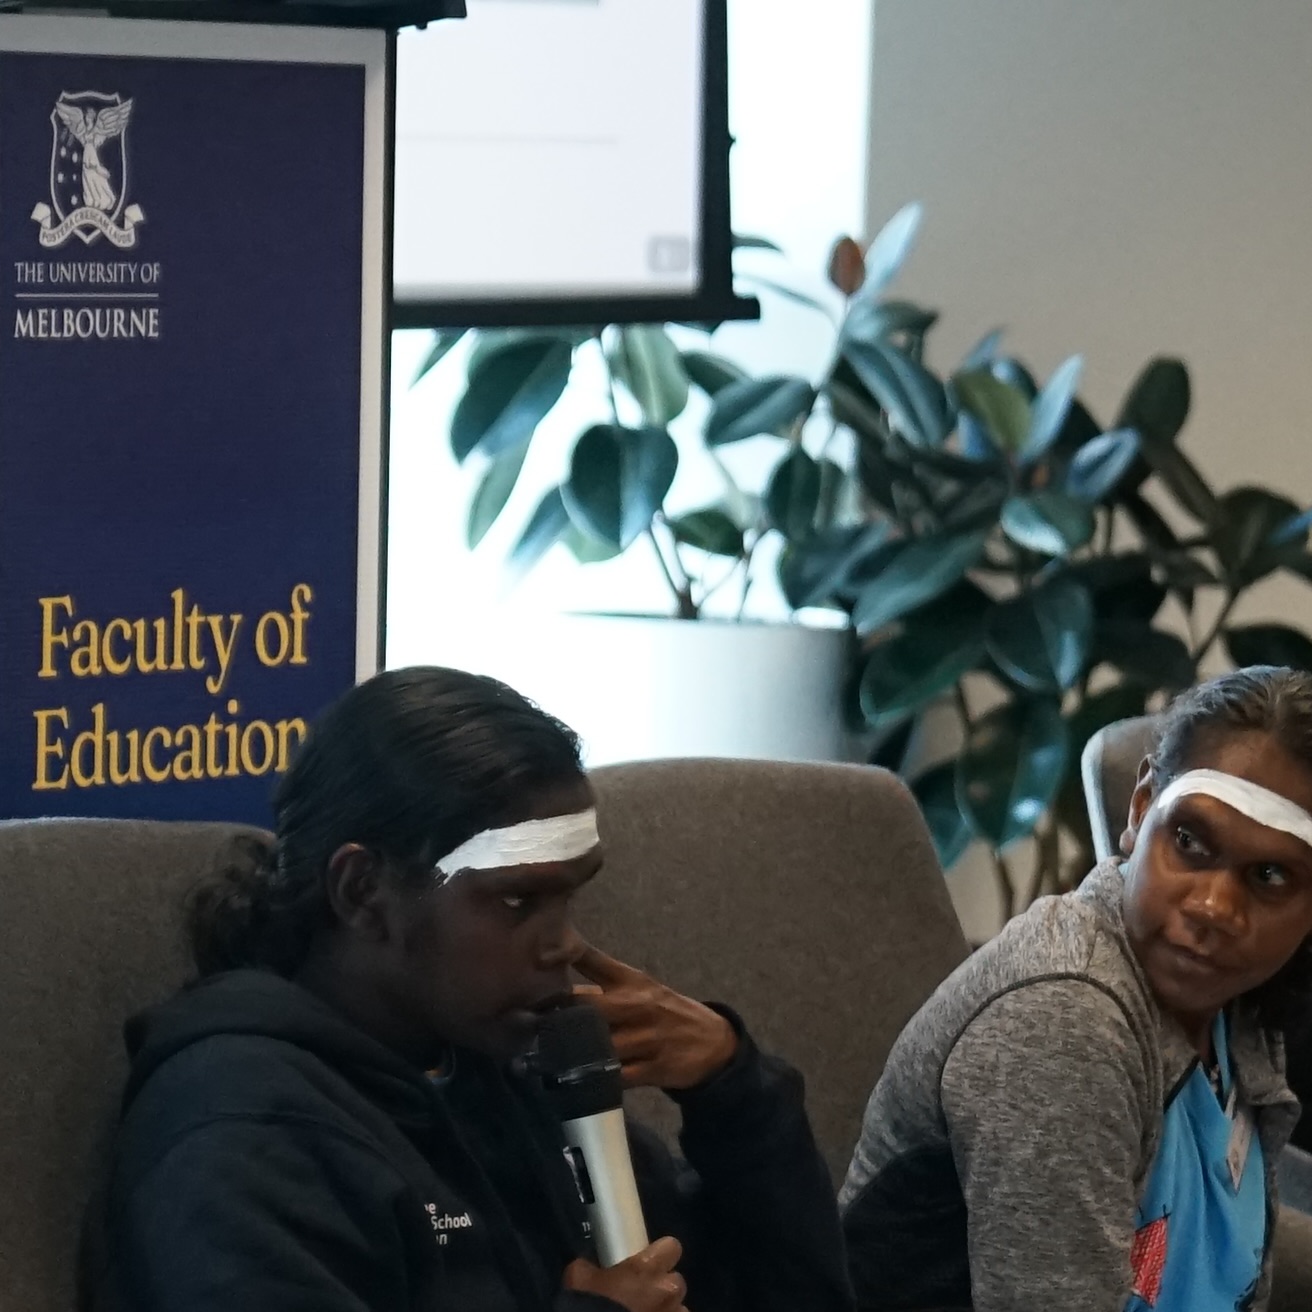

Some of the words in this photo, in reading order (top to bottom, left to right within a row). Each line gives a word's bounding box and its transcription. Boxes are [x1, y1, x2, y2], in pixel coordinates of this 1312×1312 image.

[14, 261, 44, 283] THE
[49, 261, 138, 283] UNIVERSITY
[140, 262, 161, 283] OF
[13, 307, 160, 338] MELBOURNE
[37, 587, 243, 694] Faculty
[254, 583, 313, 667] of
[31, 699, 308, 790] Education
[430, 1212, 473, 1230] School
